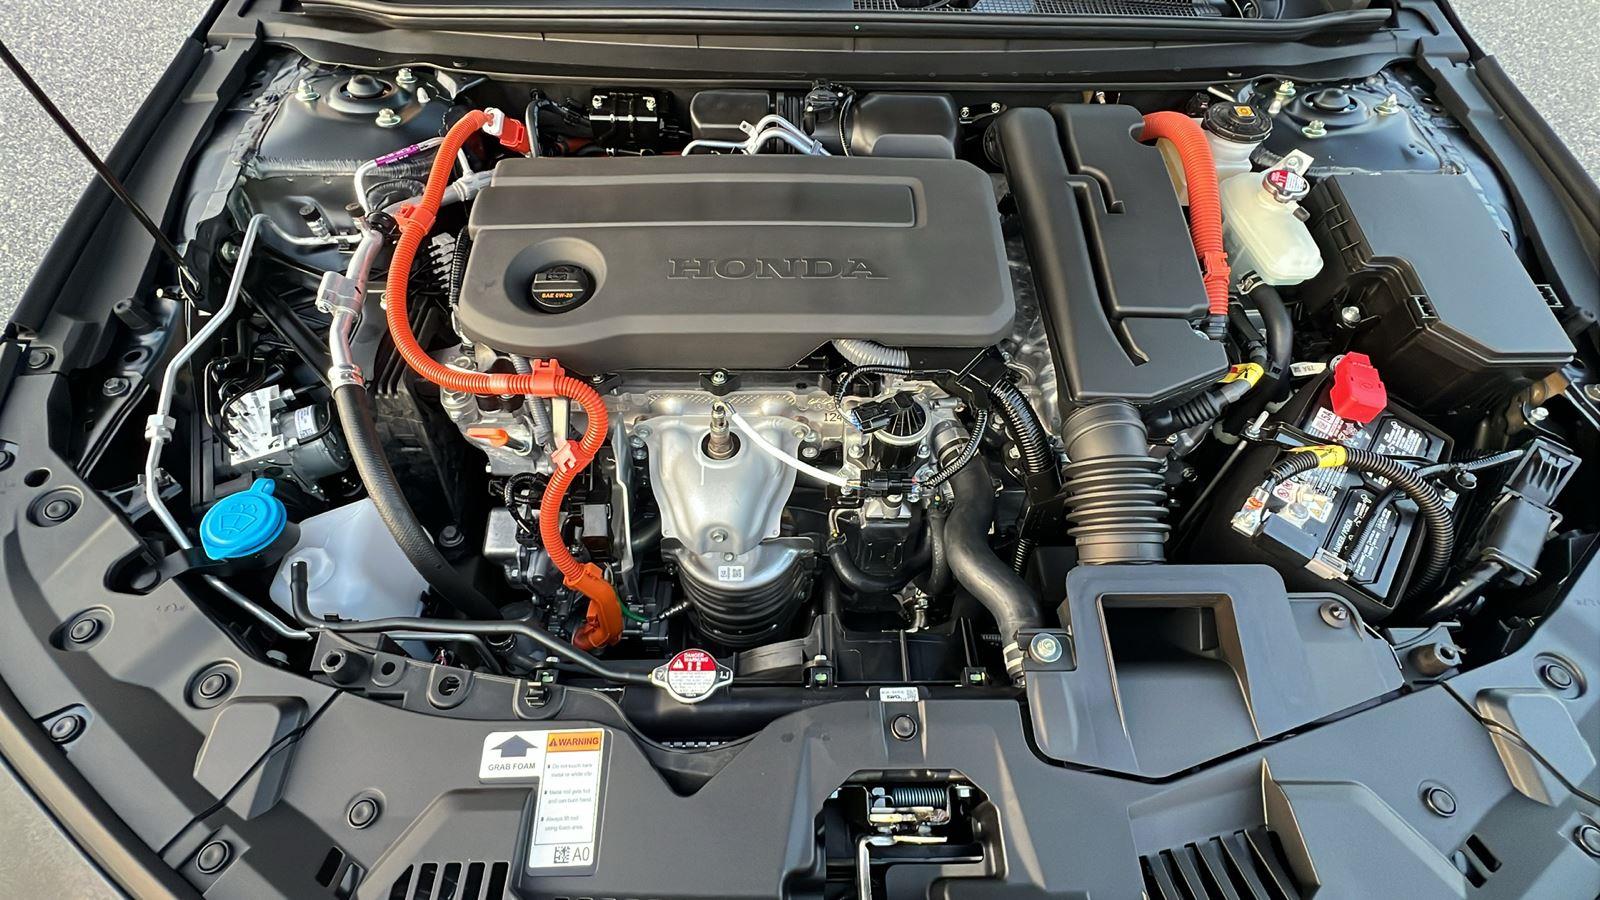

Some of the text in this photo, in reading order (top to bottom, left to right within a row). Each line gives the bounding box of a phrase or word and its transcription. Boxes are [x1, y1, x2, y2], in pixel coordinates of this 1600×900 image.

[667, 257, 888, 280] HONDA
[558, 737, 599, 746] WARNING
[488, 762, 536, 771] GRAB FOAM
[572, 846, 590, 861] A0
